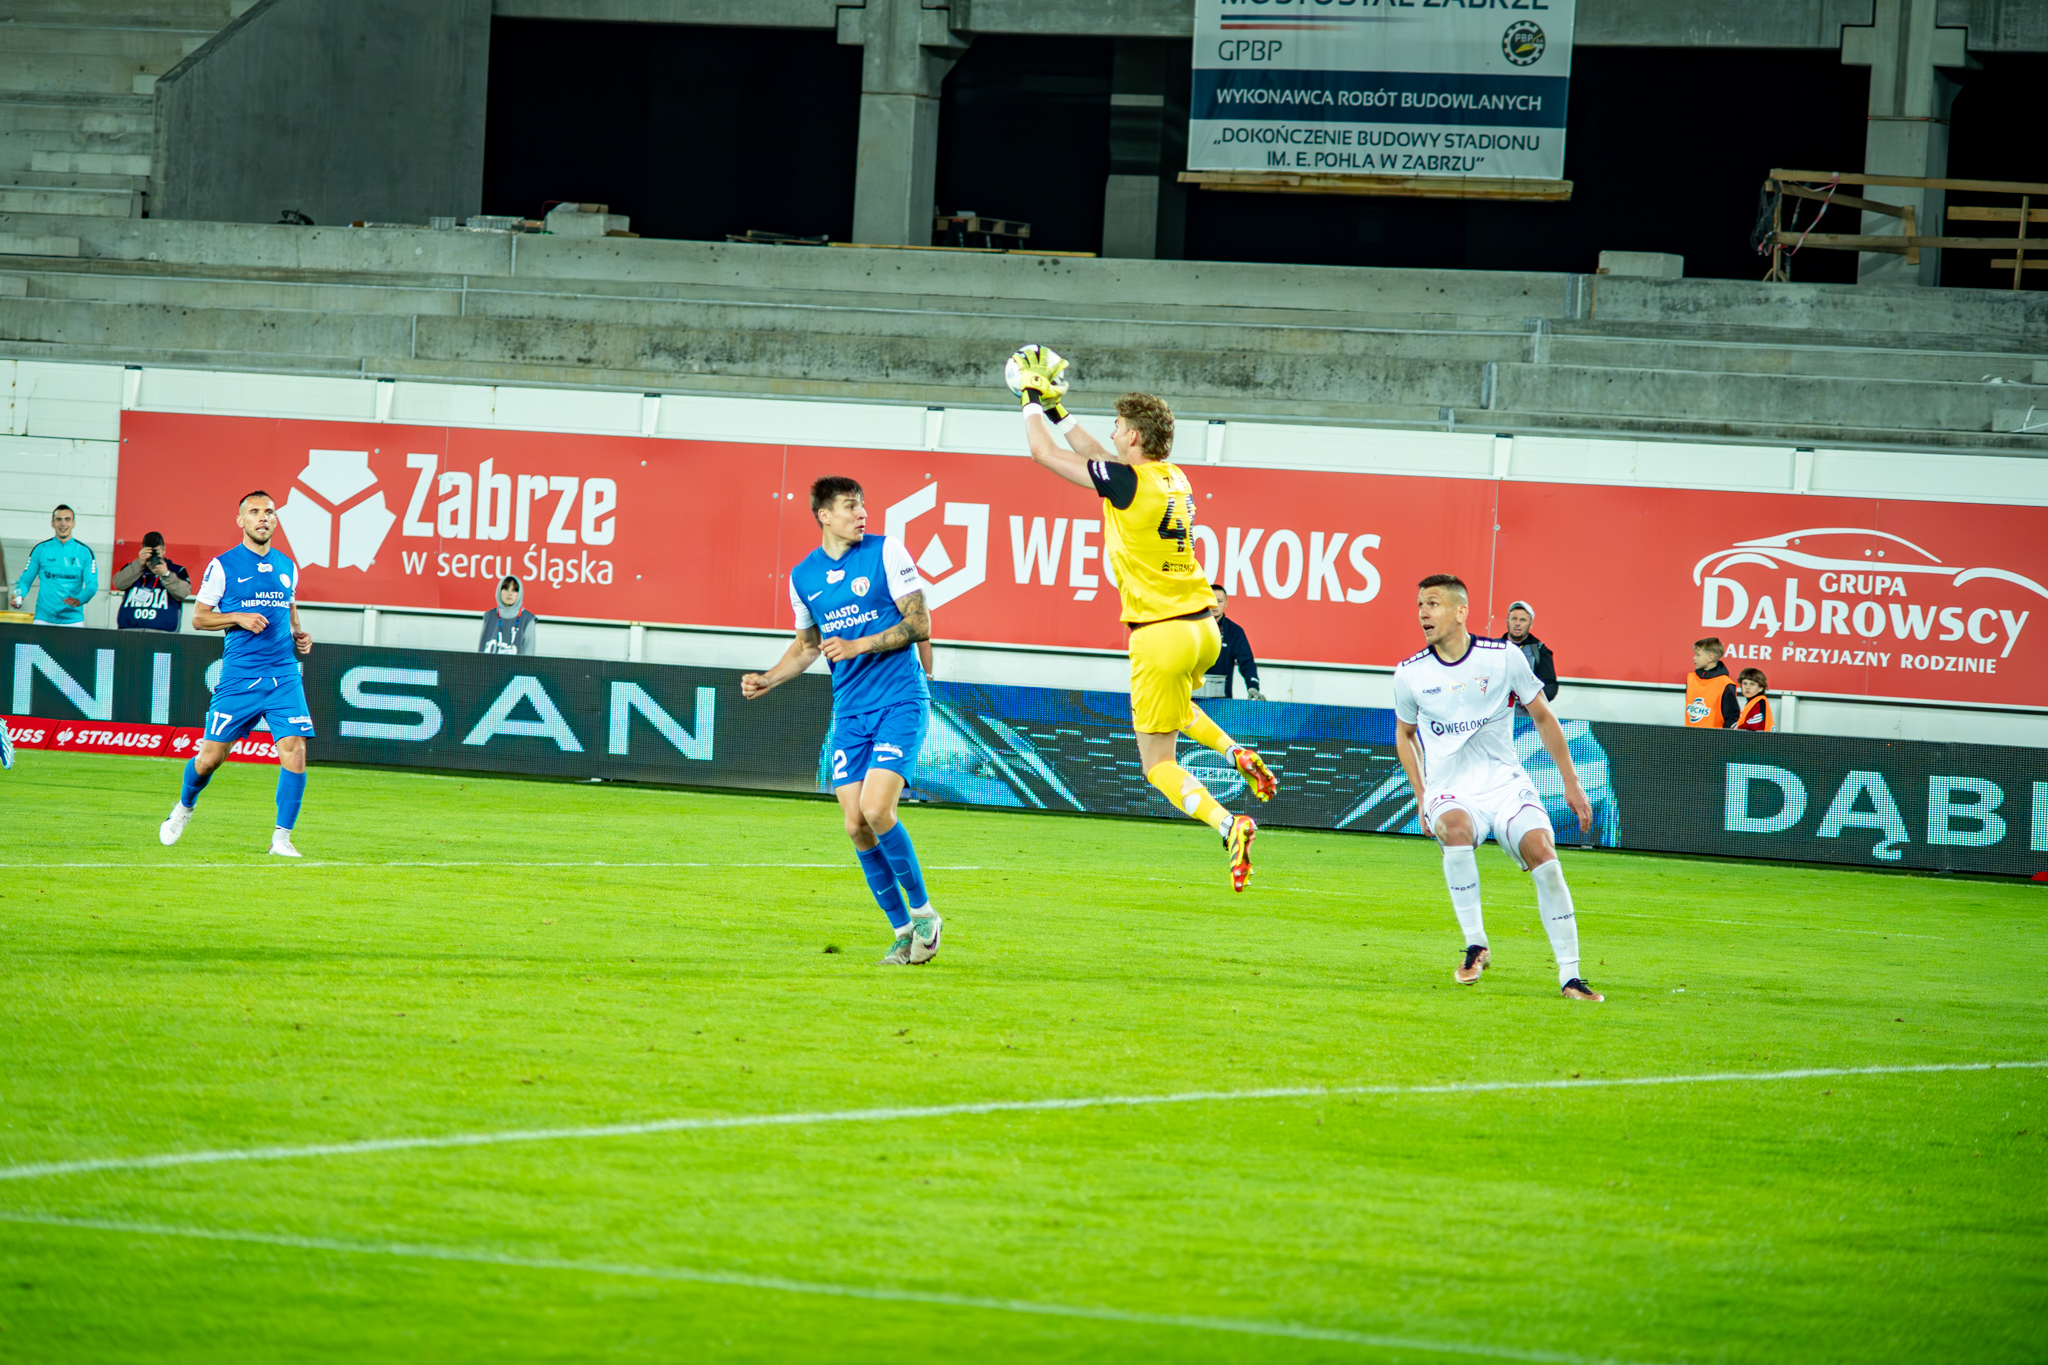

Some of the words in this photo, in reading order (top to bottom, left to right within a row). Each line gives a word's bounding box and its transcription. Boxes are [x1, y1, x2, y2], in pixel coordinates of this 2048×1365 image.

[1218, 40, 1283, 61] GPBP
[1216, 88, 1334, 106] WYKONAWCA
[1338, 88, 1398, 107] ROBÓT
[1401, 92, 1542, 111] BUDOWLANYCH
[1357, 130, 1441, 148] BUDOWY
[1444, 133, 1540, 151] STADIONU
[1267, 150, 1291, 167] IM.
[1296, 152, 1311, 167] E.
[1315, 152, 1375, 169] POHLA
[1380, 153, 1398, 169] W
[402, 453, 617, 546] Zabrze
[402, 551, 428, 576] w
[437, 552, 512, 580] sercu
[522, 543, 613, 589] Śląska
[255, 591, 284, 599] MIASTO
[1819, 572, 1907, 597] GRUPA
[134, 608, 157, 620] 009
[824, 604, 859, 621] MIASTO
[1724, 643, 1773, 661] ALER
[1782, 646, 1892, 668] PRZYJAZNY
[1900, 653, 1998, 674] RODZINIE
[12, 643, 716, 761] NISAN
[1686, 703, 1711, 716] FUCHS
[210, 711, 233, 736] 17
[75, 729, 163, 749] STRAUSS
[192, 736, 279, 758] SAUSS
